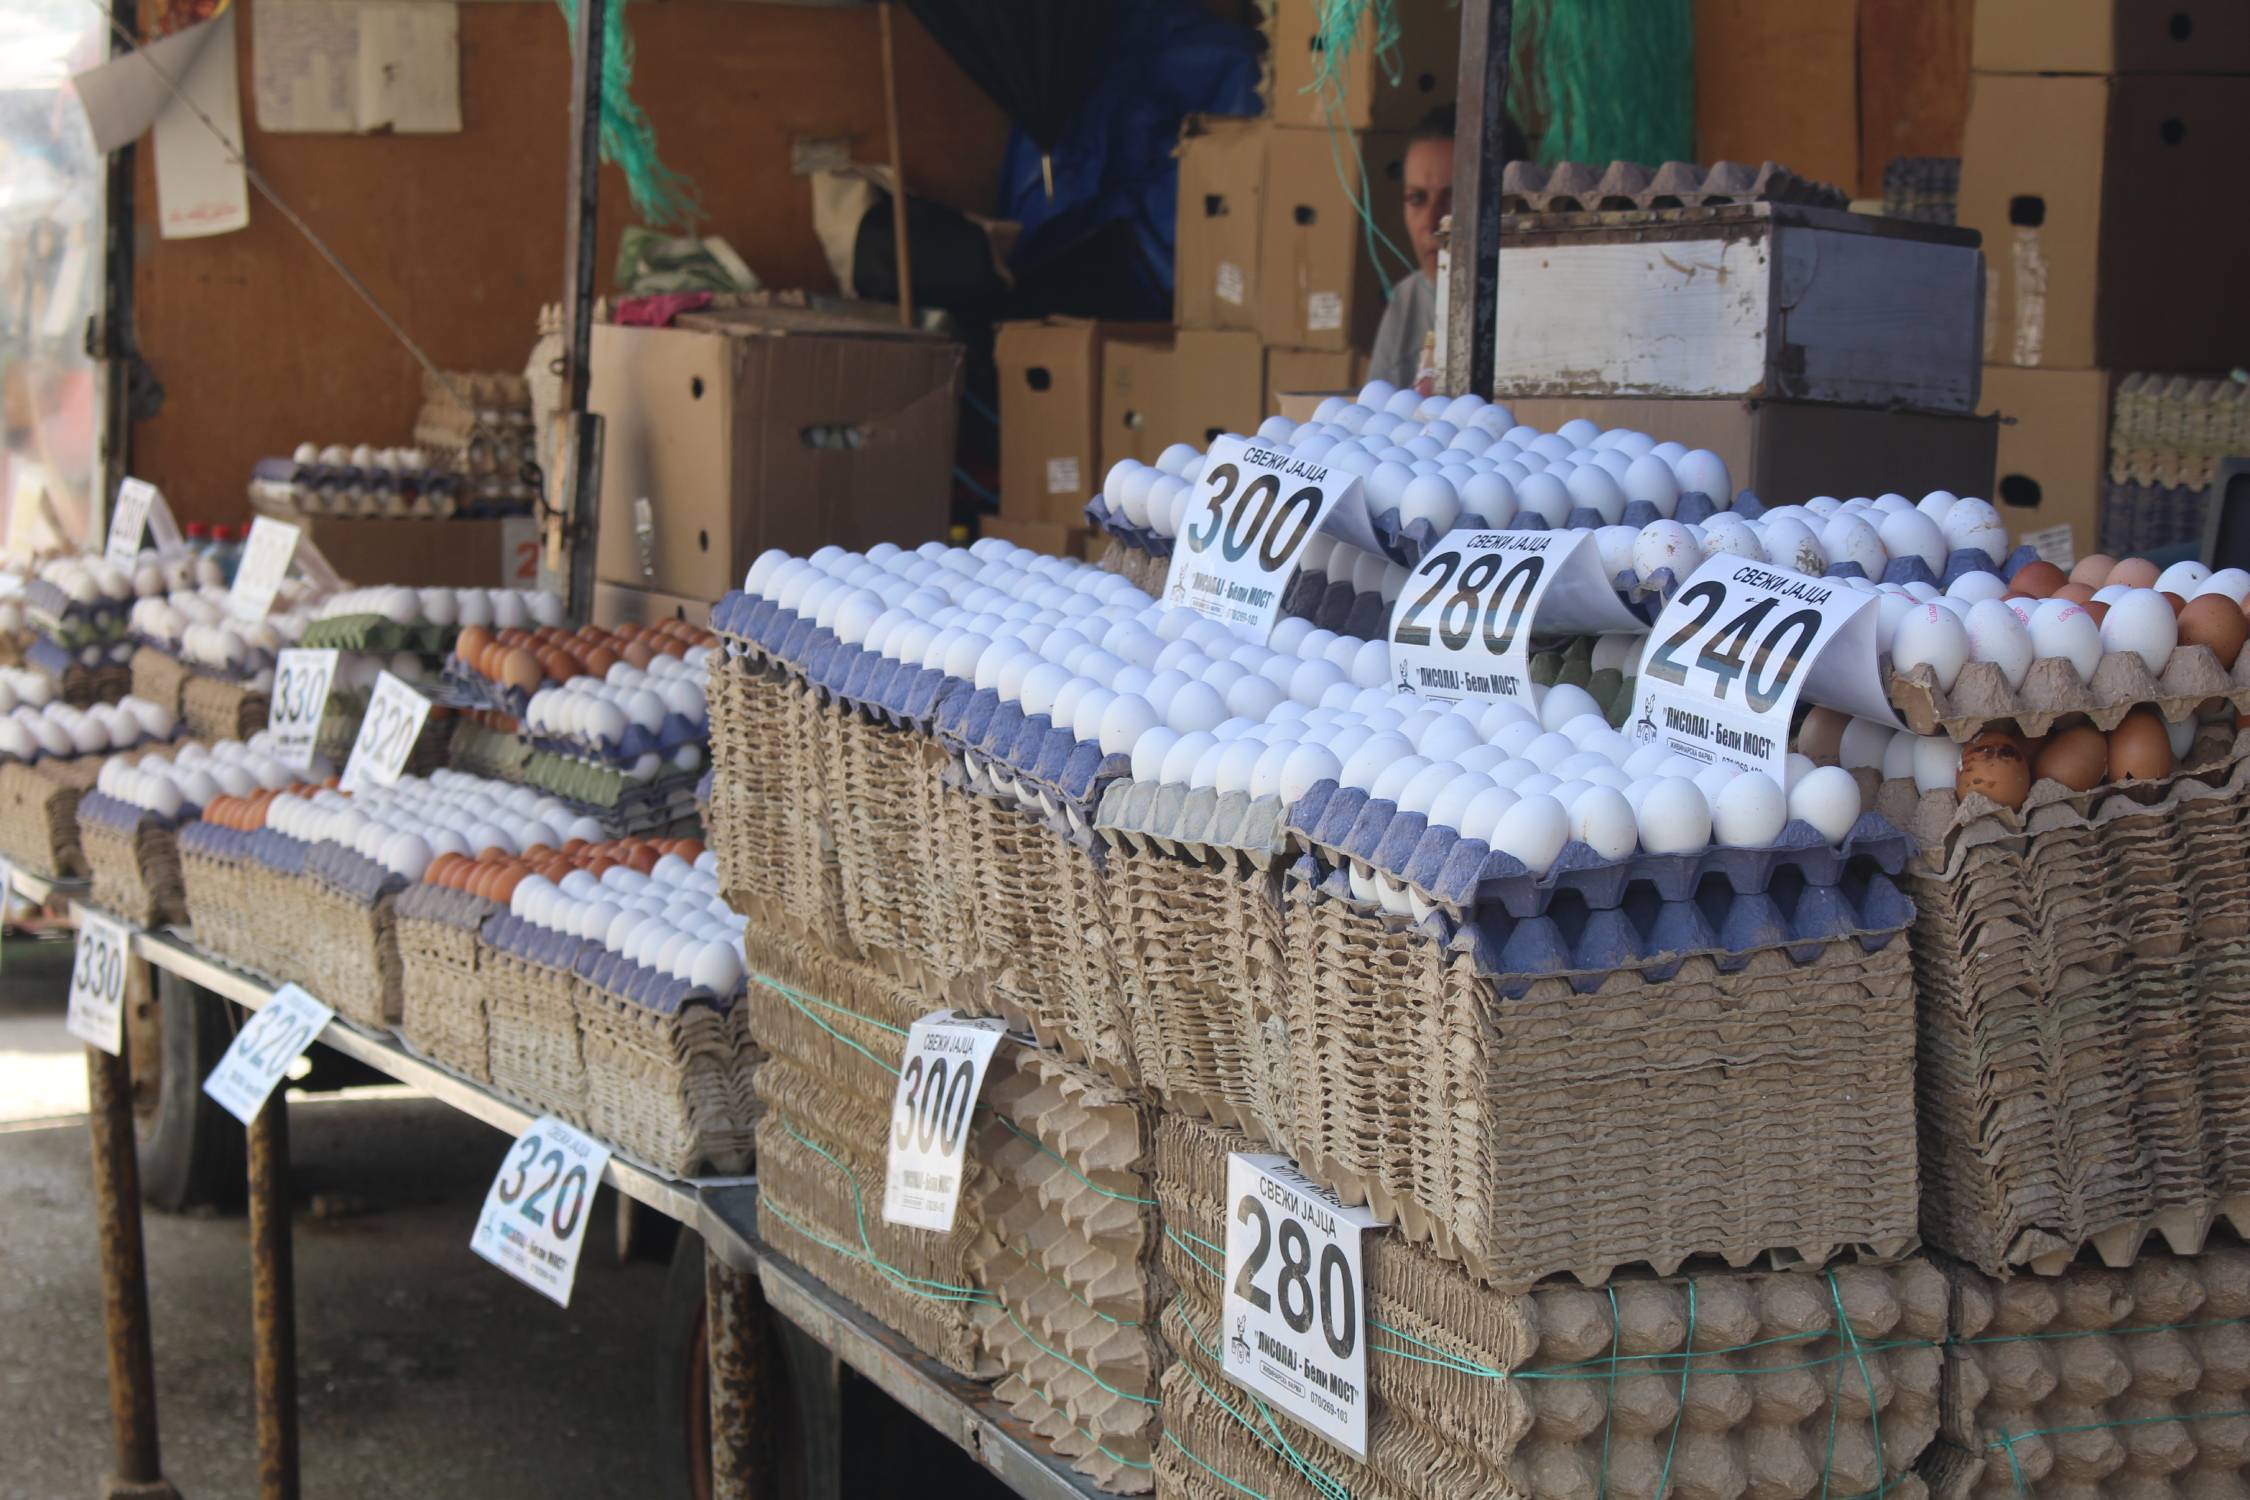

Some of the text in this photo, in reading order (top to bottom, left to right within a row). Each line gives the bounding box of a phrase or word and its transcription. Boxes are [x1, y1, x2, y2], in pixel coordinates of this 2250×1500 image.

[1243, 447, 1328, 483] СВЕЖИ ЈАЈЦА
[1187, 463, 1324, 573] 300
[1467, 535, 1552, 553] СВЕЖИ ЈАЈЦА
[1394, 551, 1545, 655] 280
[1733, 567, 1833, 605] СВЕЖИ ЈАЈЦА
[1645, 581, 1822, 714] 240
[275, 666, 327, 722] 330
[1465, 672, 1489, 694] Бели
[361, 696, 415, 771] 320
[1716, 722, 1741, 751] Бели
[77, 935, 120, 1003] 330
[238, 1004, 312, 1077] 320
[895, 1055, 974, 1158] 300
[499, 1135, 588, 1241] 320
[1259, 1176, 1337, 1239] СВЕЖИ ЈАЈЦА
[1234, 1194, 1356, 1360] 280
[1304, 1357, 1328, 1391] Бели
[1310, 1391, 1348, 1425] 070/269-103
